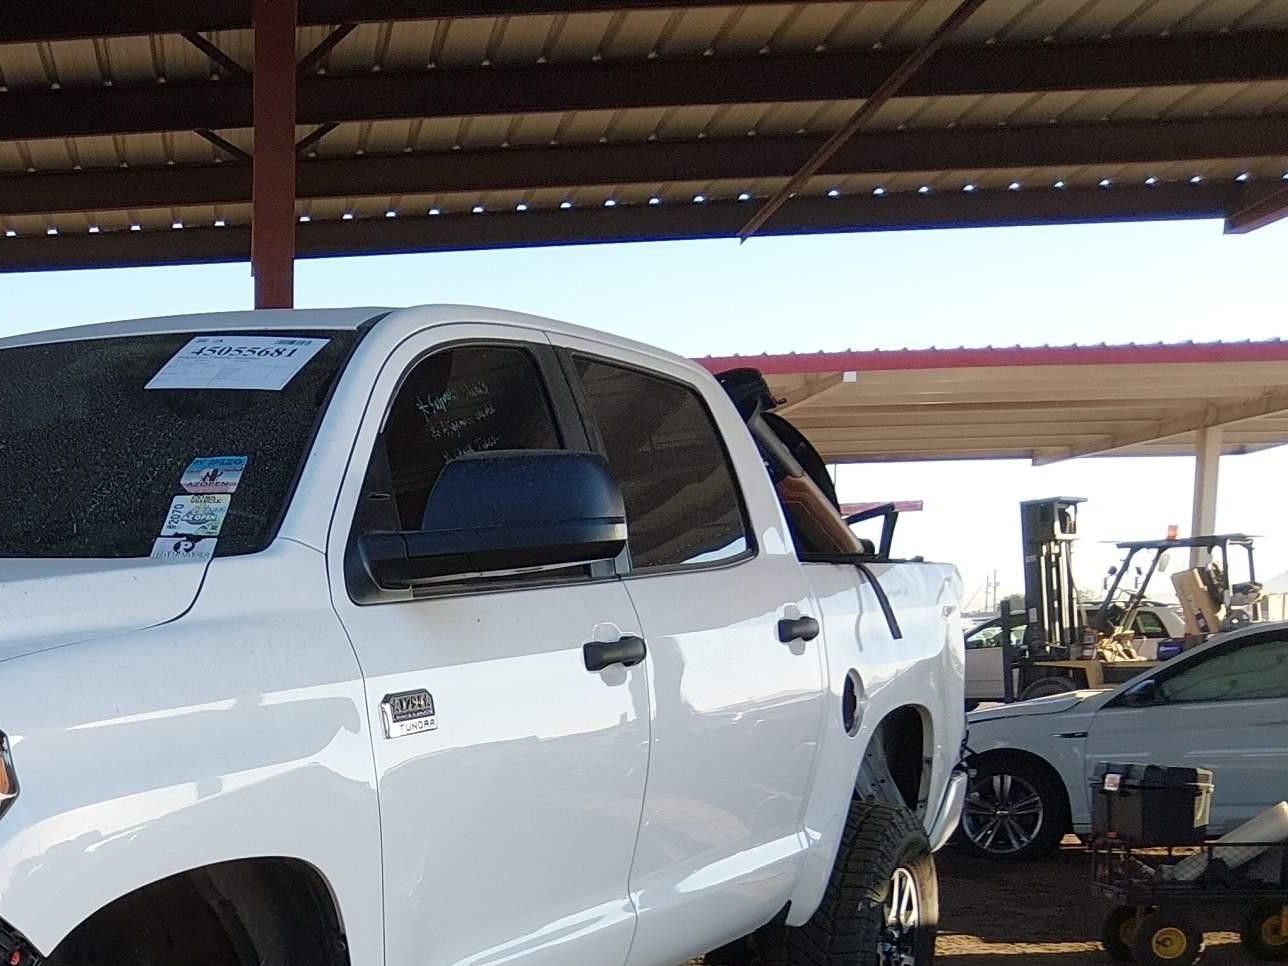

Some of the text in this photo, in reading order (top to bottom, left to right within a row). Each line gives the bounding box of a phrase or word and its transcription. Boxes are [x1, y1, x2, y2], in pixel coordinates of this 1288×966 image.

[191, 346, 299, 359] 45055681
[168, 503, 185, 525] 2070
[399, 718, 435, 733] TUNDRA
